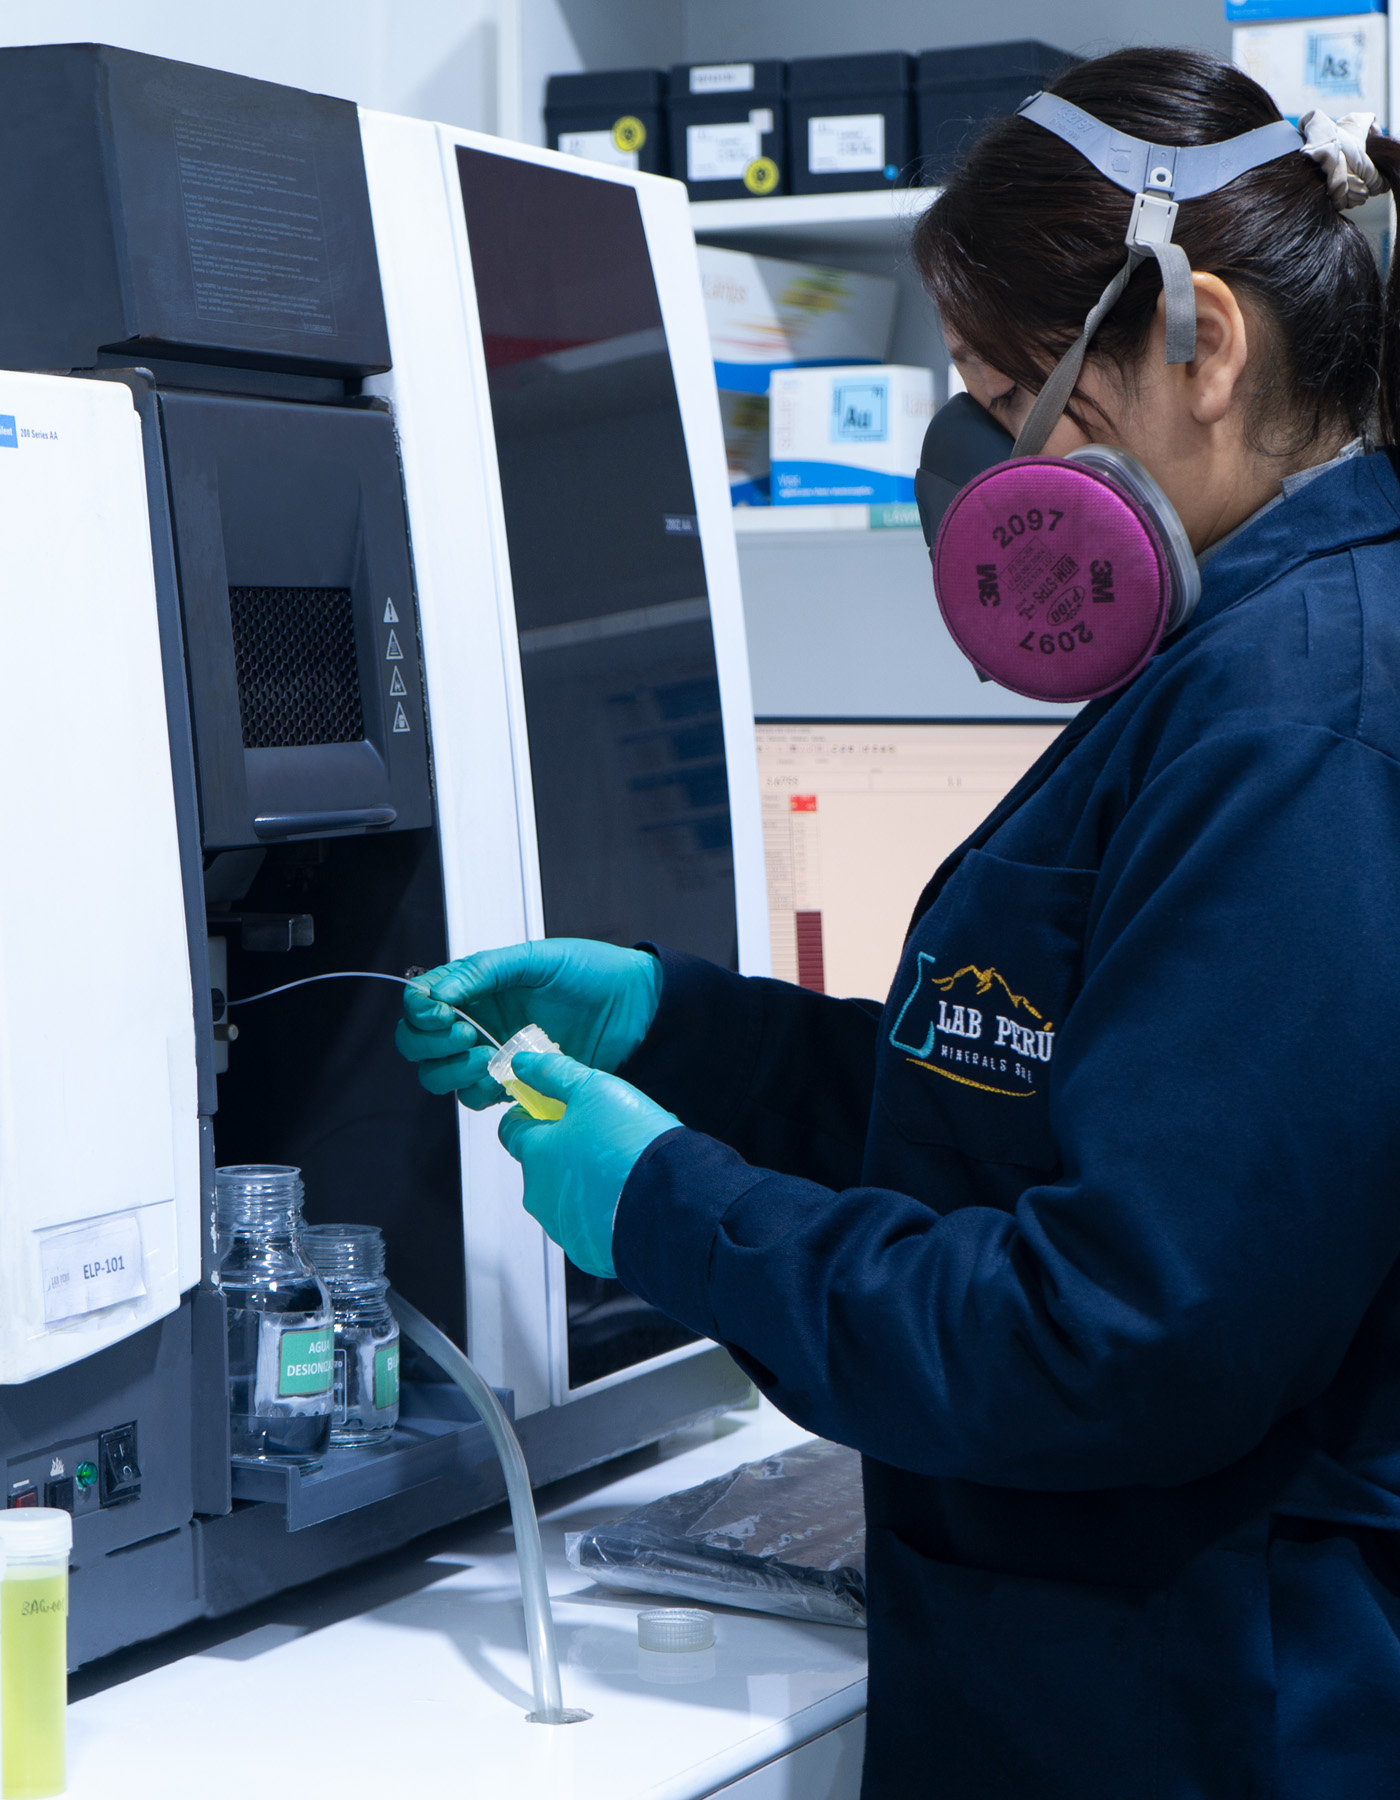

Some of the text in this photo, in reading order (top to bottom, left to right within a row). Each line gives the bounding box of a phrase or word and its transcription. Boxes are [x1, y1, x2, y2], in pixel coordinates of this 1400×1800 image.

[1320, 53, 1349, 79] As
[20, 427, 58, 440] 200 Series AA
[991, 508, 1065, 549] 2097
[975, 563, 1002, 608] 3M
[1089, 559, 1115, 604] 3M
[1049, 589, 1083, 624] P100
[1018, 620, 1095, 656] 2097
[936, 999, 983, 1039] LAB
[940, 1044, 1033, 1084] MINERALS SRL
[83, 1255, 125, 1280] ELP-101
[308, 1340, 331, 1355] AGUA
